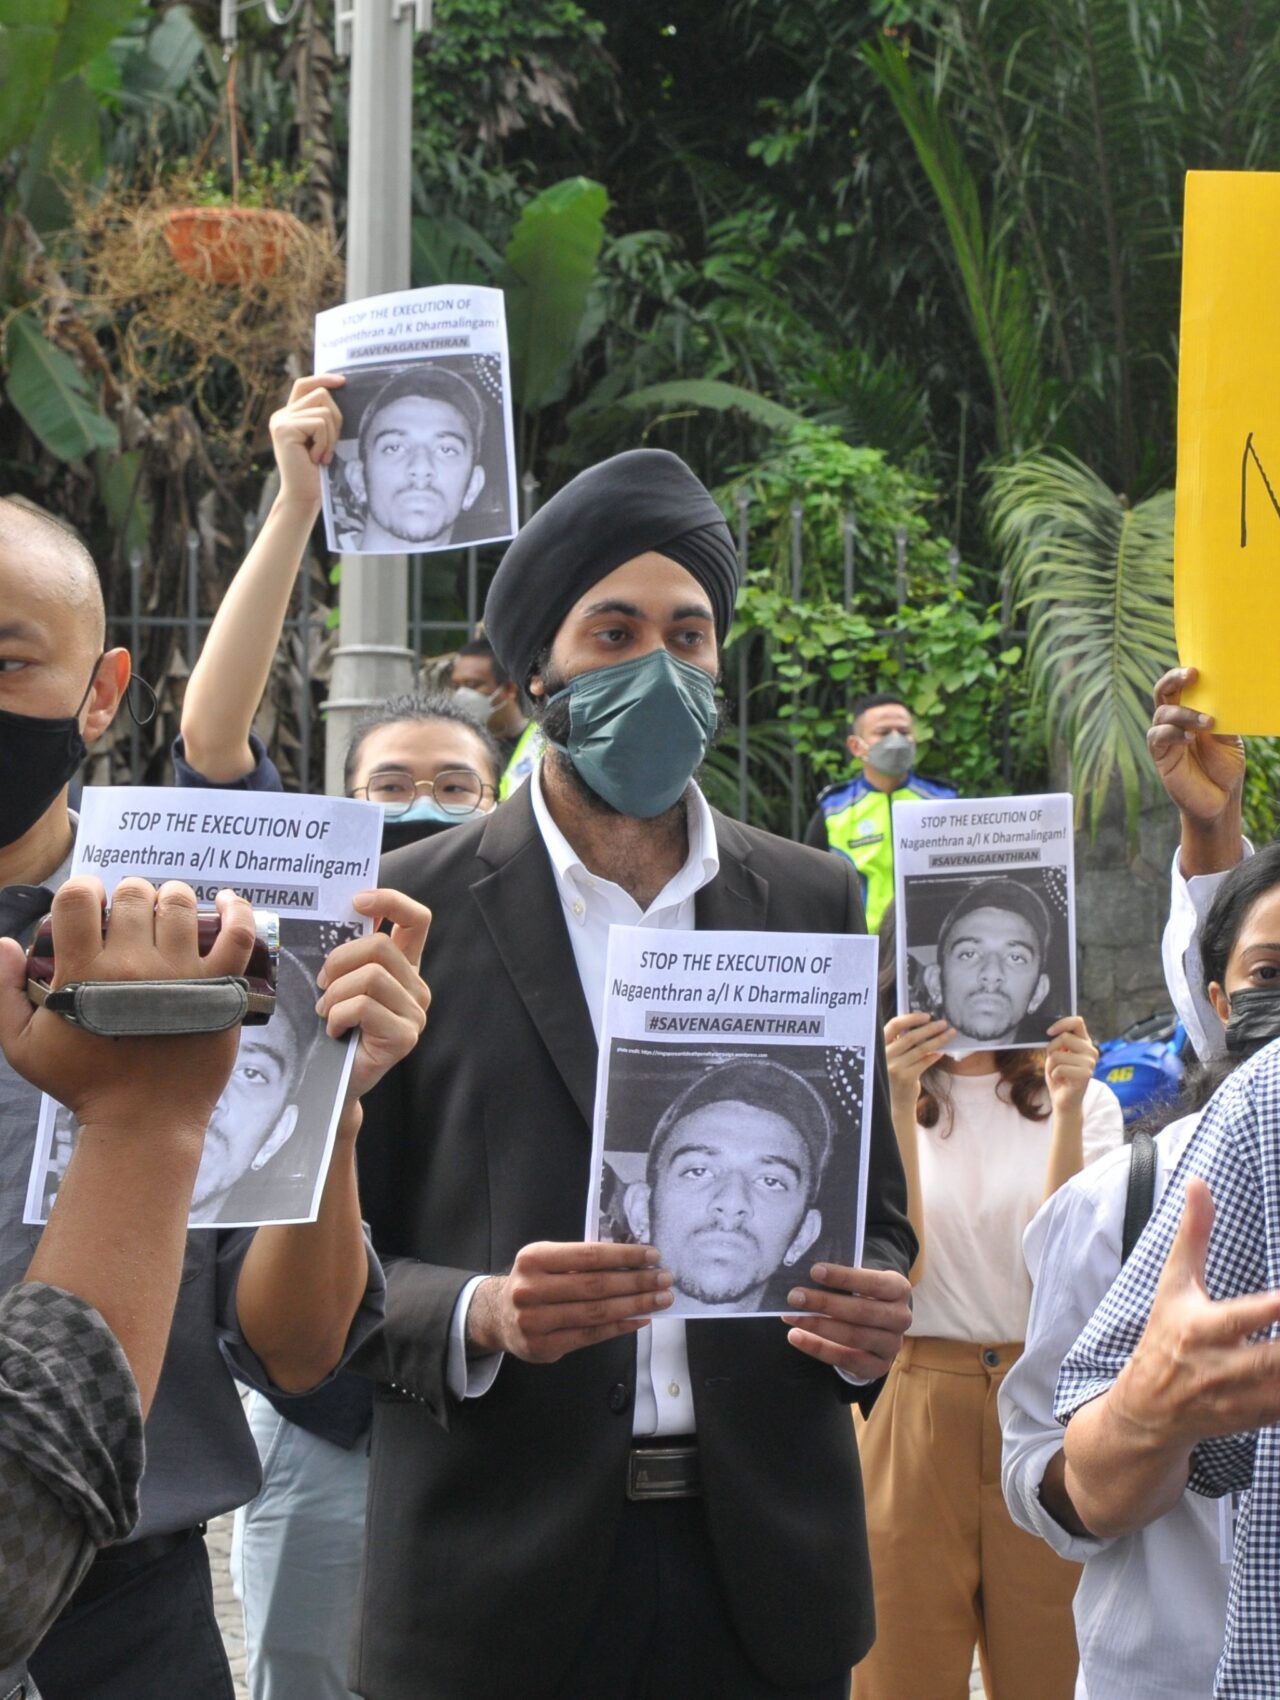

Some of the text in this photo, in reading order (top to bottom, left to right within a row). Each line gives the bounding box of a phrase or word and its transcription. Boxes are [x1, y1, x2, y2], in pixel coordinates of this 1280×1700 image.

[370, 307, 388, 321] THE
[392, 300, 453, 318] EXECUTION
[457, 299, 472, 311] OF
[416, 315, 500, 333] Dharmalingam!
[118, 811, 331, 840] STOP THE EXECUTION OF
[922, 809, 1043, 829] STOP THE EXECUTION OF
[900, 835, 964, 852] Nagaenthran
[983, 832, 990, 844] K
[992, 827, 1066, 844] Dharmalingam!
[81, 844, 185, 868] Nagaenthran
[219, 849, 232, 869] K
[235, 850, 370, 879] Dharmalingam!
[931, 851, 1039, 868] #SAVENAGAENTHRAN
[640, 951, 832, 974] STOP THE EXECUTION OF
[612, 978, 869, 1009] Nagaenthran a/l K Dharmalingam!
[649, 1016, 821, 1034] #SAVENAGAENTHRAN
[1106, 1065, 1135, 1083] 46
